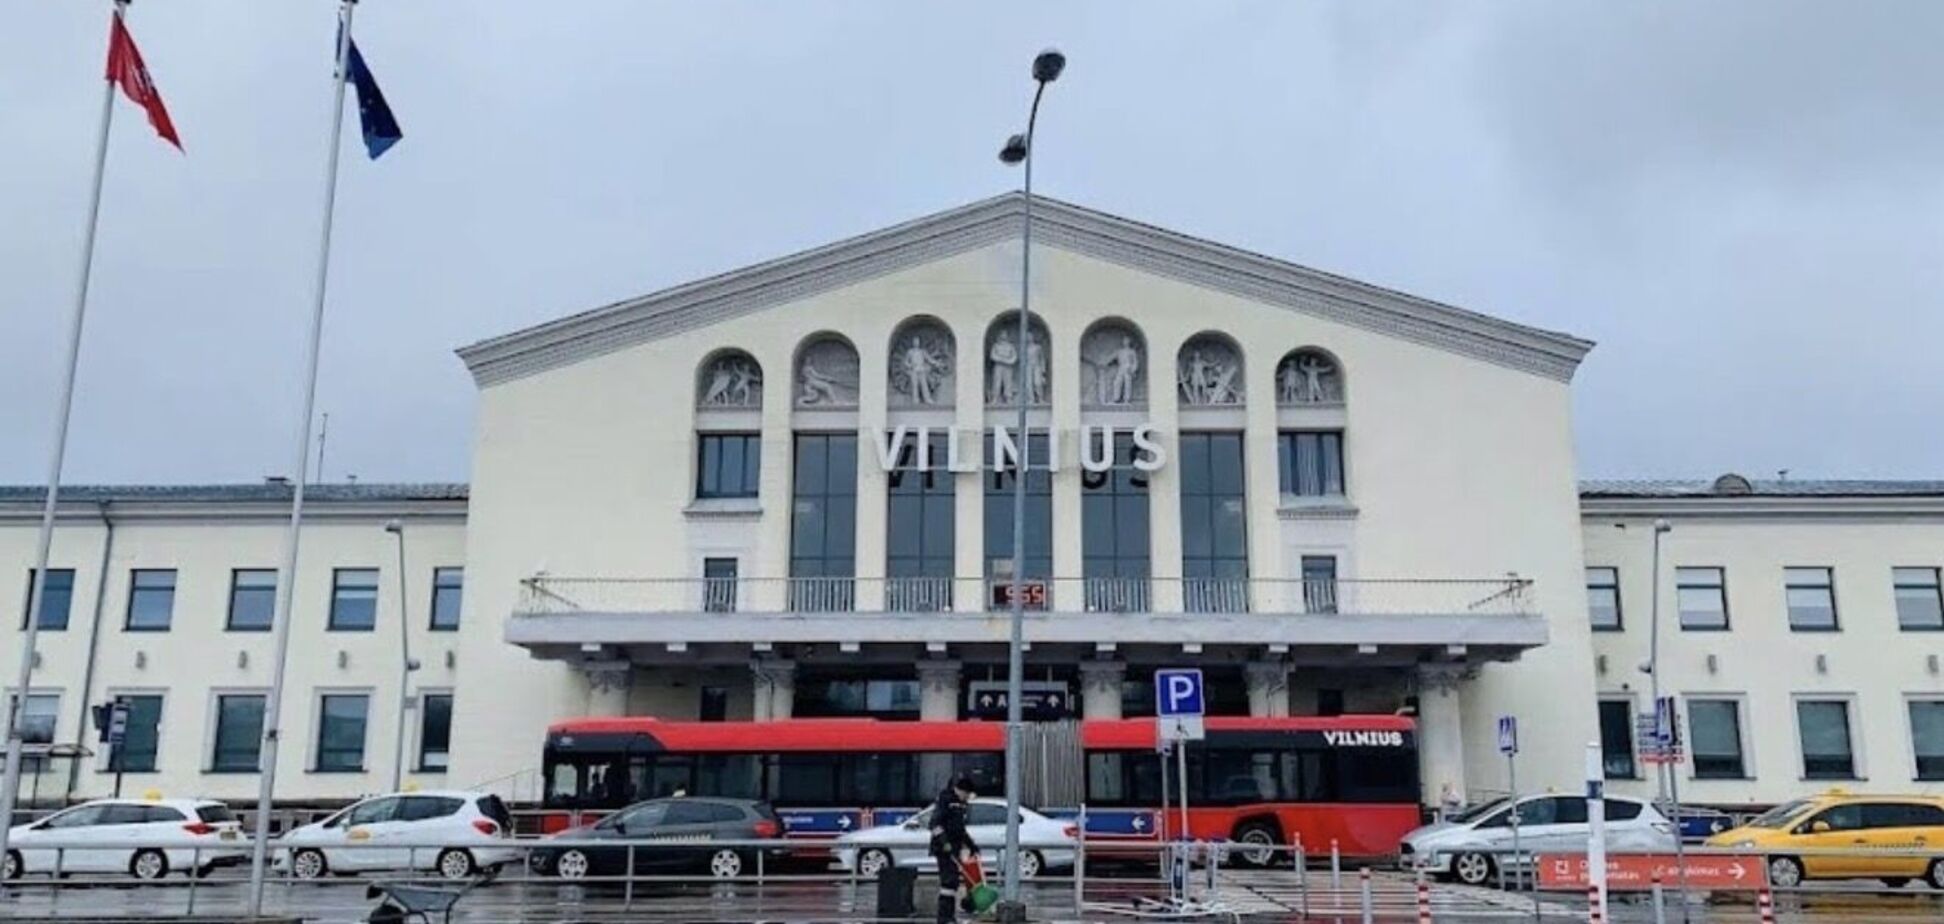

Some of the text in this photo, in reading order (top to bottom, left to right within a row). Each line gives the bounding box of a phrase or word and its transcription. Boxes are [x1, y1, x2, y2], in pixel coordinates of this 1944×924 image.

[872, 424, 1168, 472] VILNIUS
[1169, 676, 1194, 711] P
[1323, 731, 1403, 746] VILNIUS
